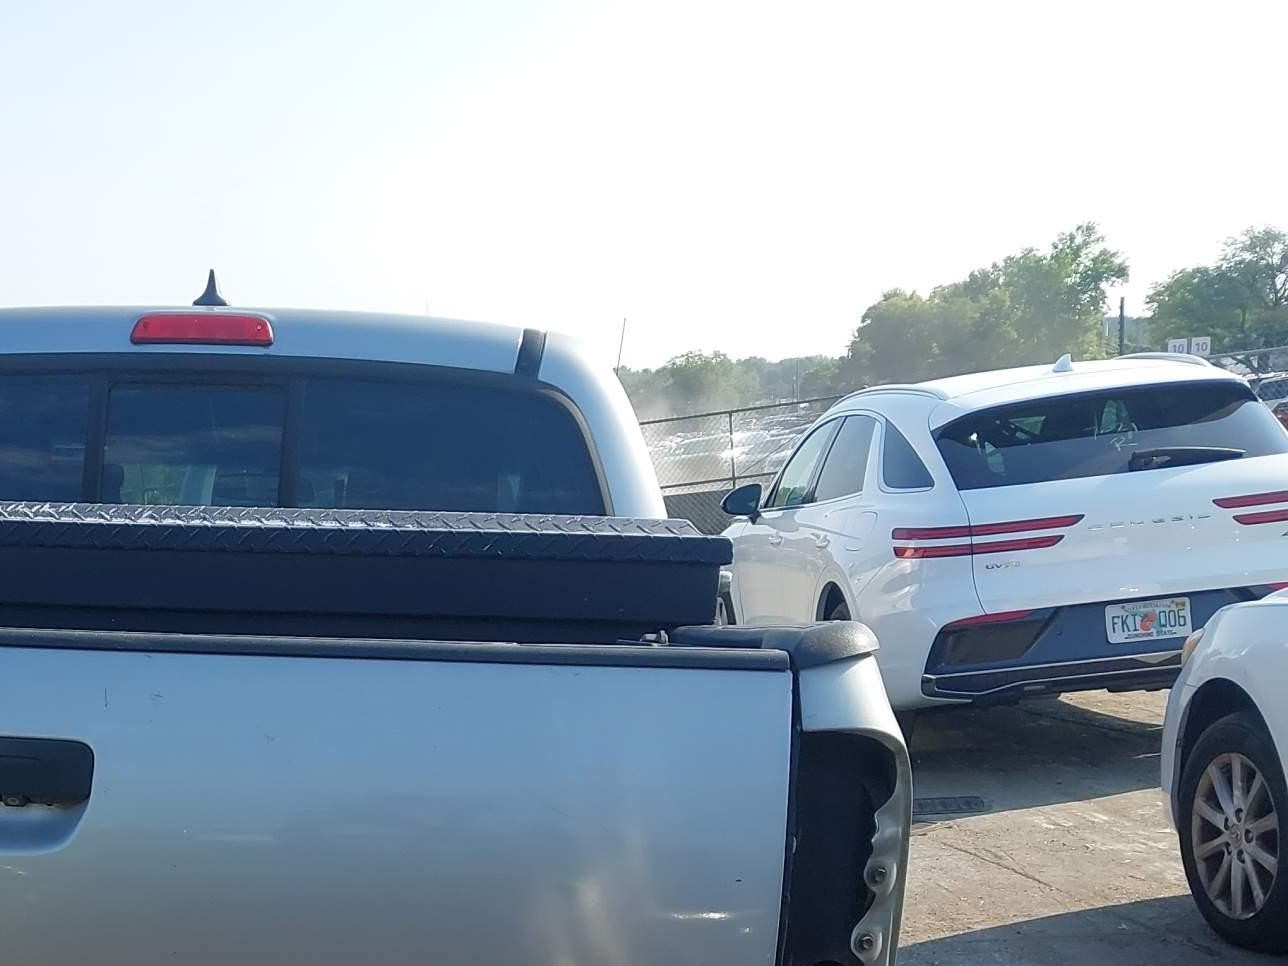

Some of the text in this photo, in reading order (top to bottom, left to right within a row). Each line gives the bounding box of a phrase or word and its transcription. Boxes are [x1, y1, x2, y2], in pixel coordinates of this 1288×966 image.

[1173, 343, 1185, 353] 10
[1195, 342, 1208, 352] 10
[1112, 614, 1140, 633] FKI
